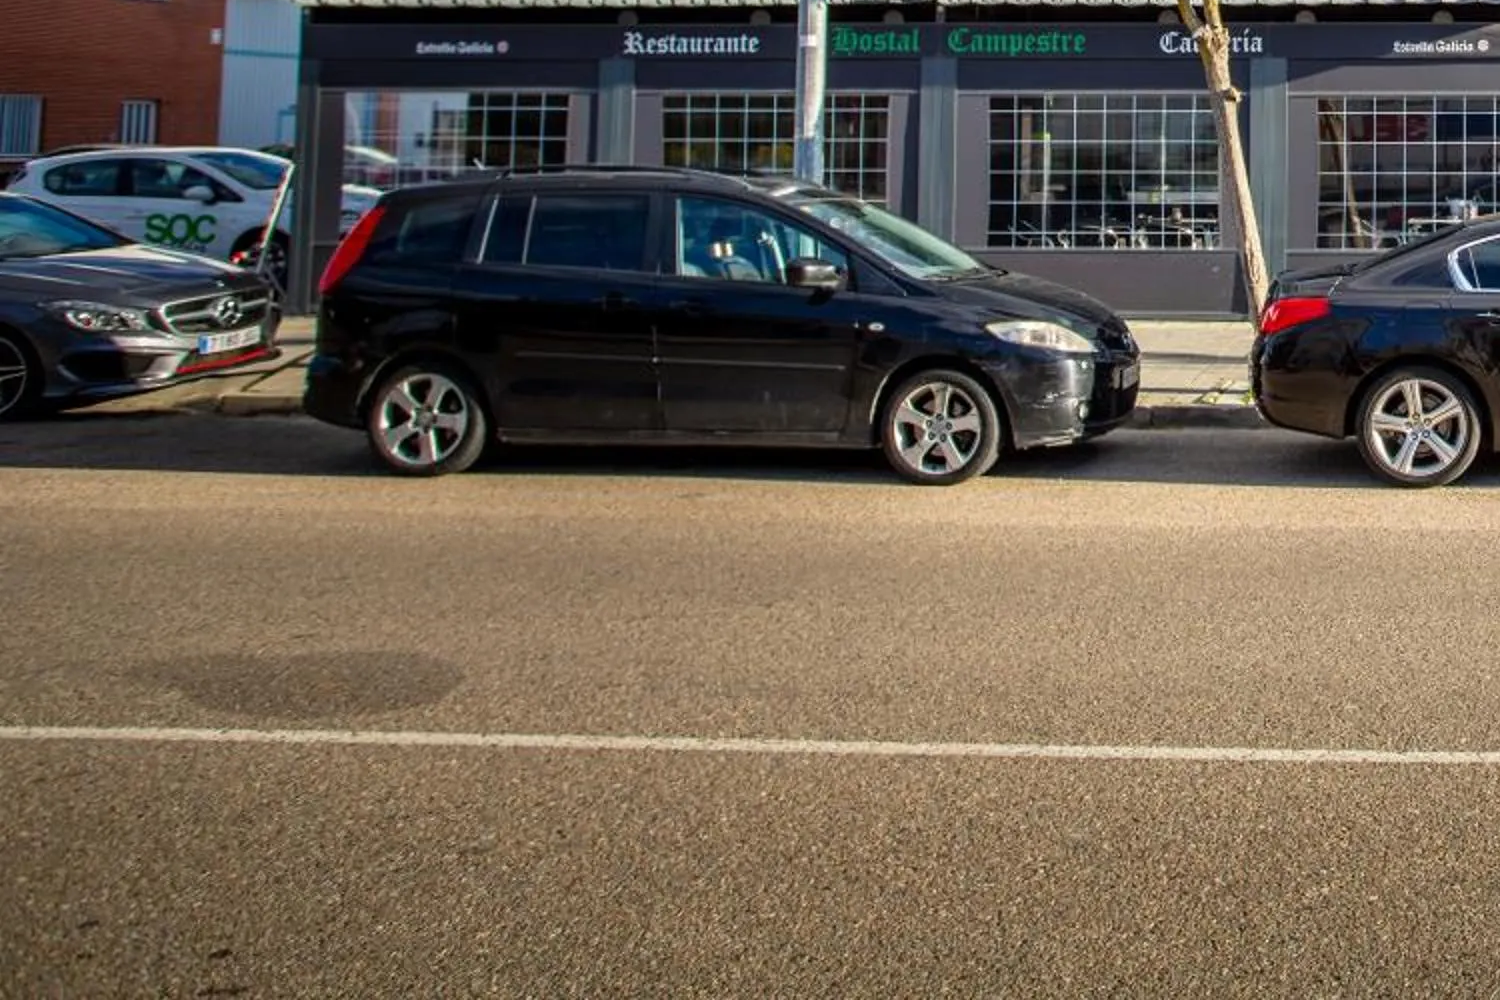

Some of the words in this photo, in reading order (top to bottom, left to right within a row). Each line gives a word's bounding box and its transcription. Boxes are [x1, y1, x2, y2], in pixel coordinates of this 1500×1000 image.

[622, 31, 760, 55] Restaurante
[832, 26, 919, 56] Hostal
[947, 26, 1087, 57] Campestre
[1160, 27, 1263, 54] Caría
[144, 213, 216, 245] SOC
